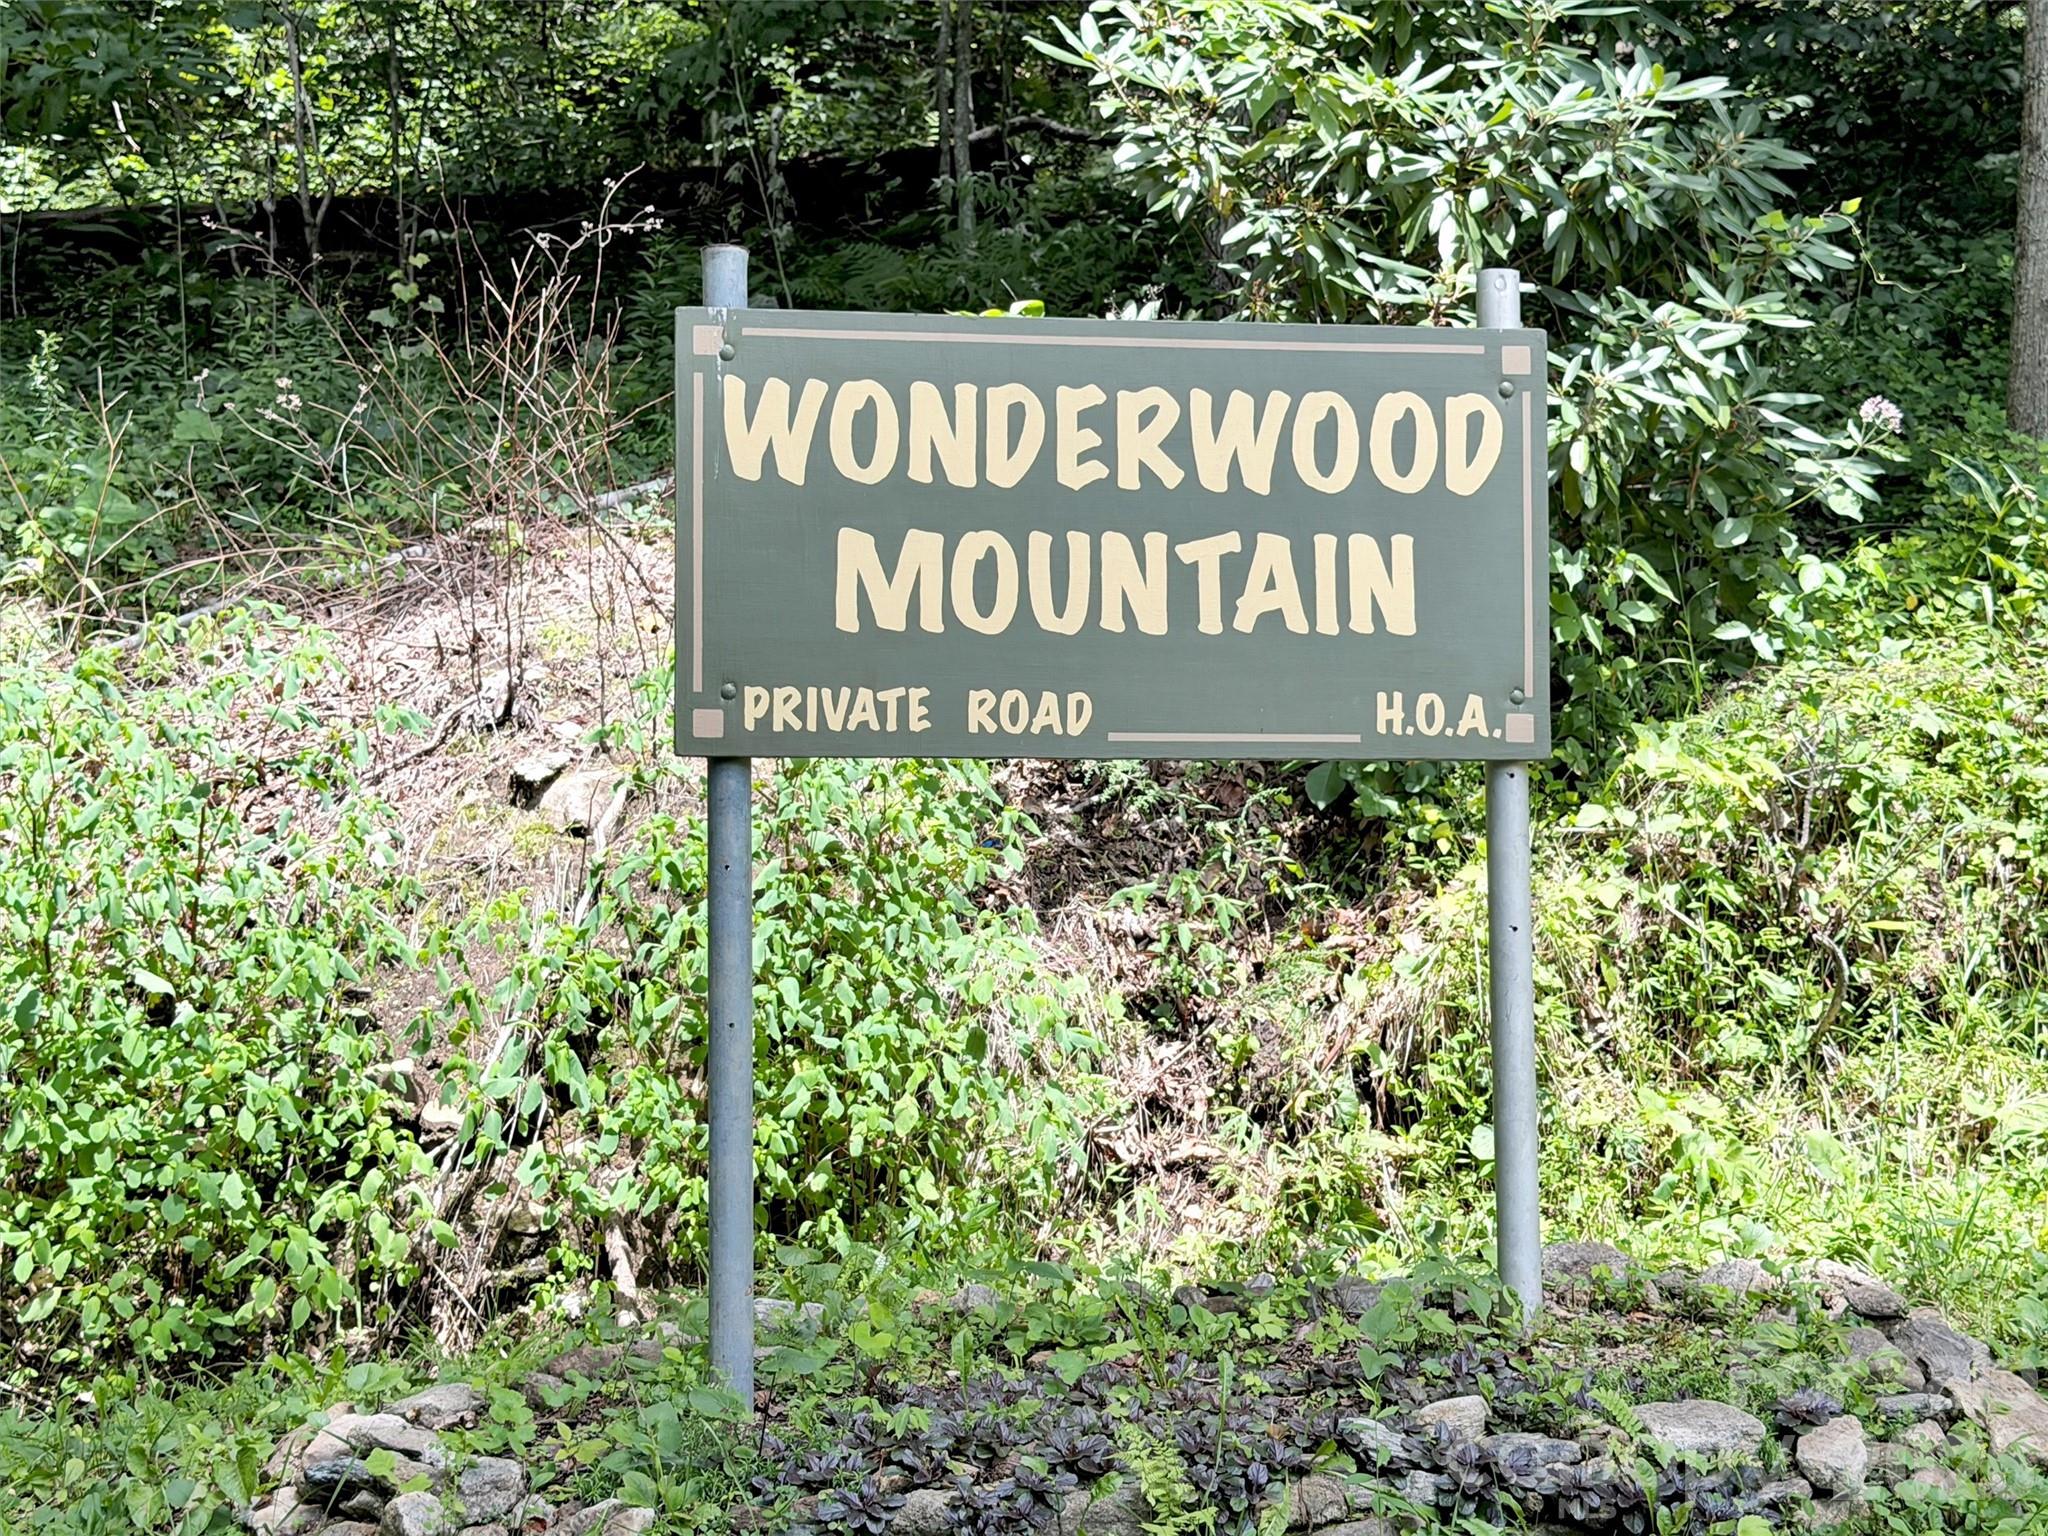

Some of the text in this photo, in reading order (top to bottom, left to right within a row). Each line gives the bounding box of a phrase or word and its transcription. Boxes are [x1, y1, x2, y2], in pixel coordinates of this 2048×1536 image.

[724, 375, 1503, 495] WONDERWOOD
[836, 527, 1416, 635] MOUNTAIN
[743, 686, 1092, 737] PRIVATE ROAD
[1377, 694, 1503, 738] H.O.A.
